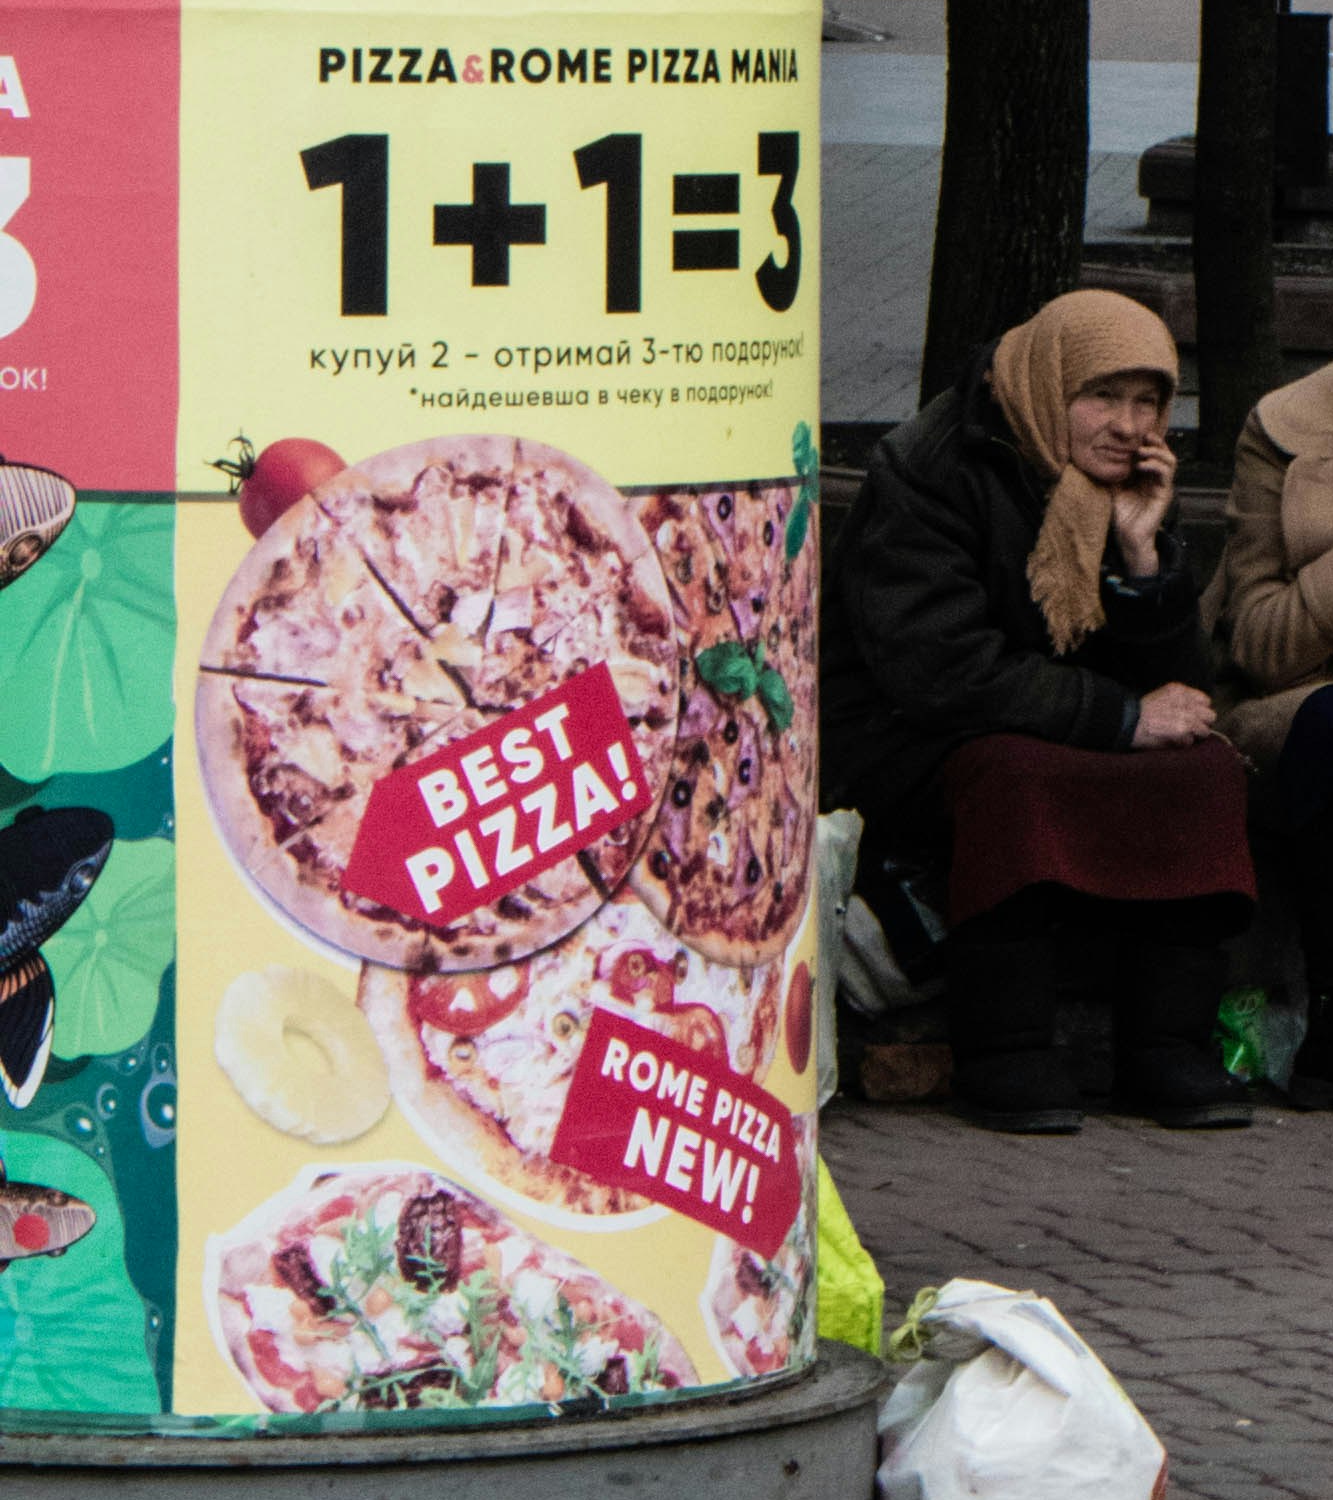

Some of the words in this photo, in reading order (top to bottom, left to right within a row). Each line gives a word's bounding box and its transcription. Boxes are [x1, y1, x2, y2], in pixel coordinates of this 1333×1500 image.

[318, 46, 613, 85] PIZZA&ROME
[627, 46, 721, 85] PIZZA
[730, 46, 800, 84] MANIA
[299, 130, 803, 318] 1+1=3
[309, 339, 416, 376] купуй
[431, 341, 450, 369] 2
[494, 337, 632, 374] отримай
[642, 336, 704, 366] 3-тю
[711, 330, 805, 368] подарунок!
[599, 390, 610, 406] в
[617, 388, 664, 410] чеку
[670, 388, 680, 404] в
[686, 379, 774, 407] подарунок!
[405, 740, 639, 916] PIZZA!
[417, 702, 574, 830] BEST
[600, 1034, 709, 1120] ROME
[711, 1090, 783, 1166] PIZZA
[623, 1107, 761, 1227] NEW!
